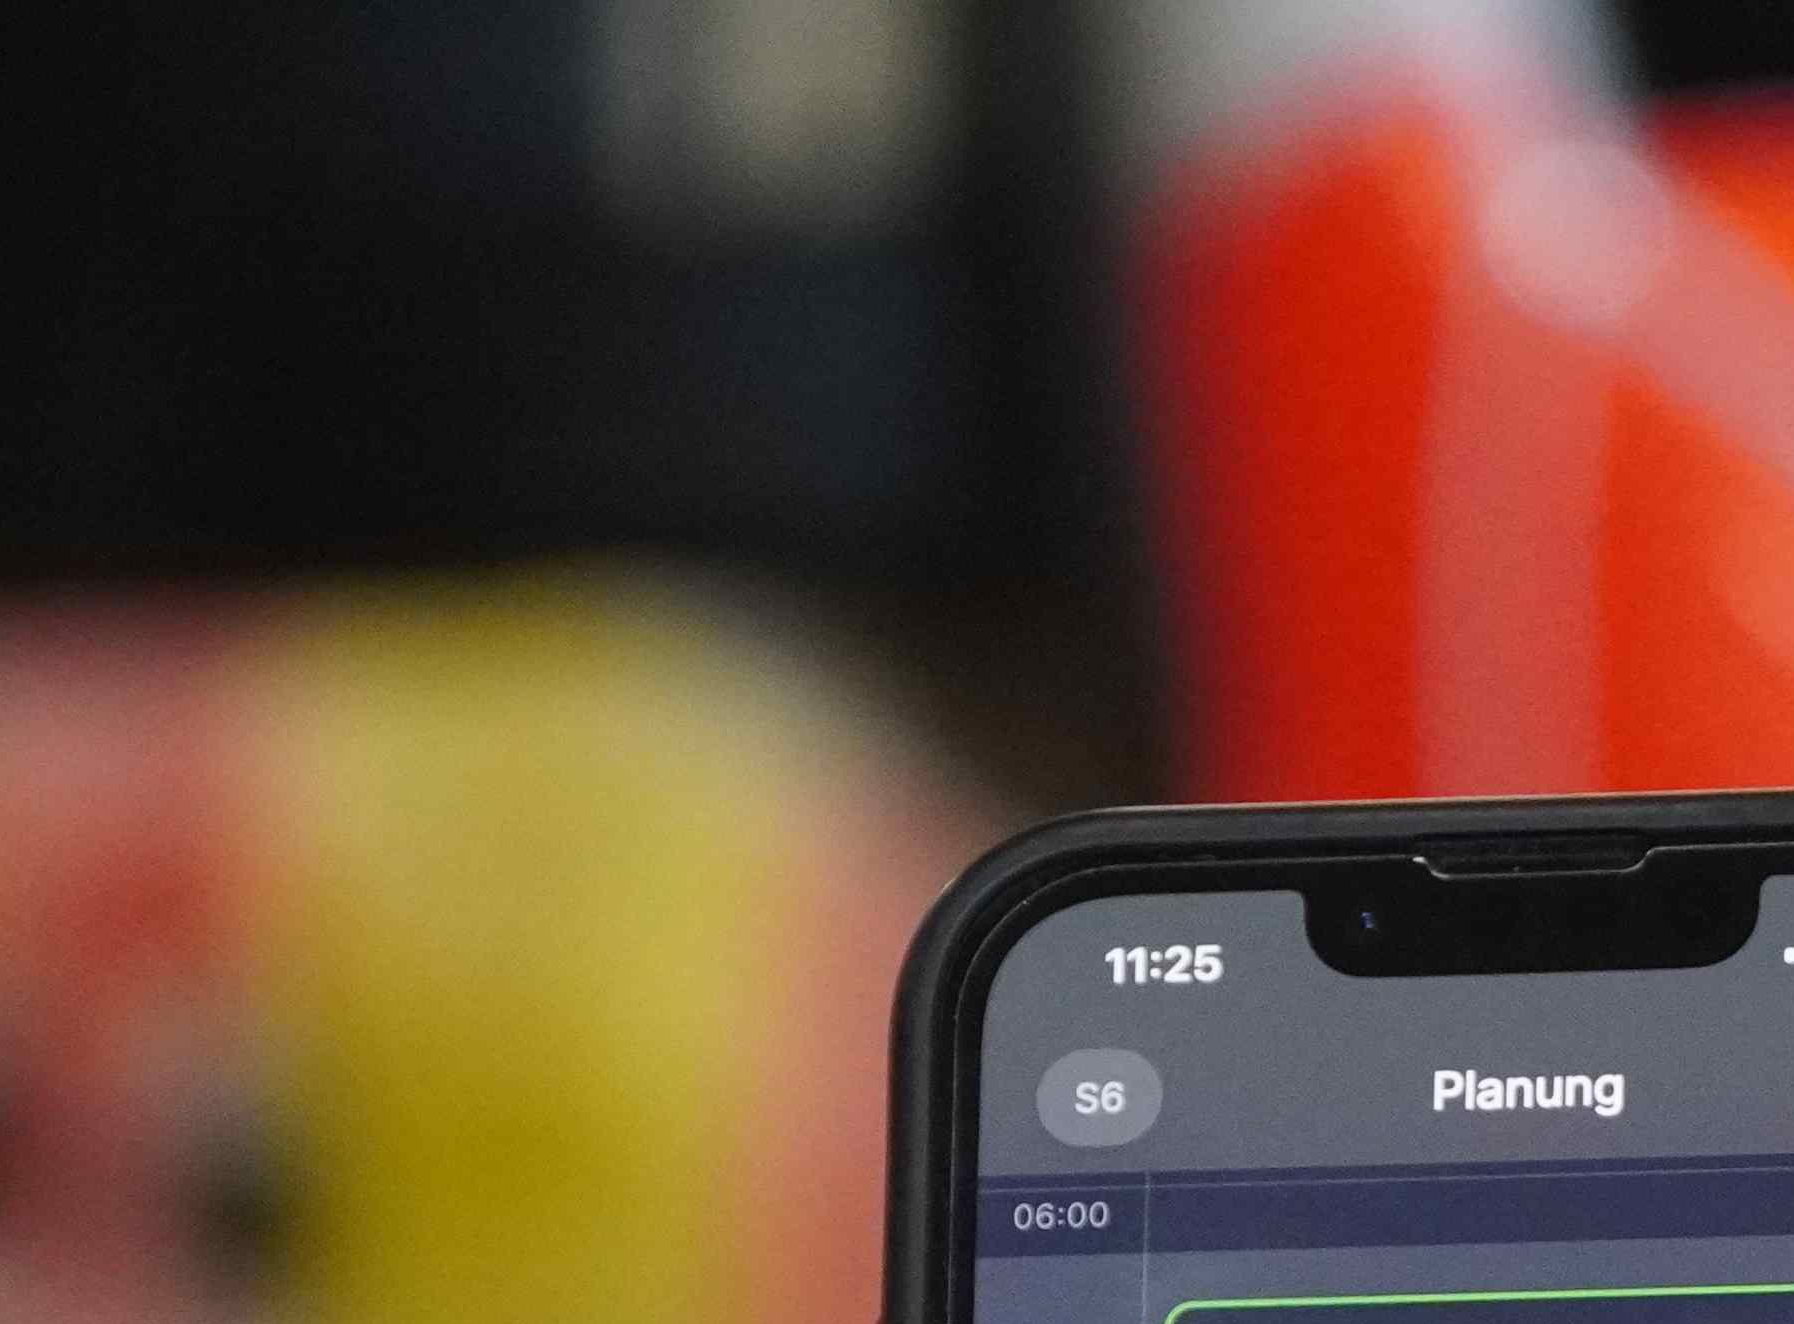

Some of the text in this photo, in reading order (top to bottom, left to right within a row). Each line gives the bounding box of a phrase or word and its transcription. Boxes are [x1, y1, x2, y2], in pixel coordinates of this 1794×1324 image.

[1105, 944, 1223, 984] 11:25
[1075, 1081, 1125, 1115] S6
[1433, 1069, 1624, 1117] Planung
[1013, 1200, 1110, 1231] 06:00
